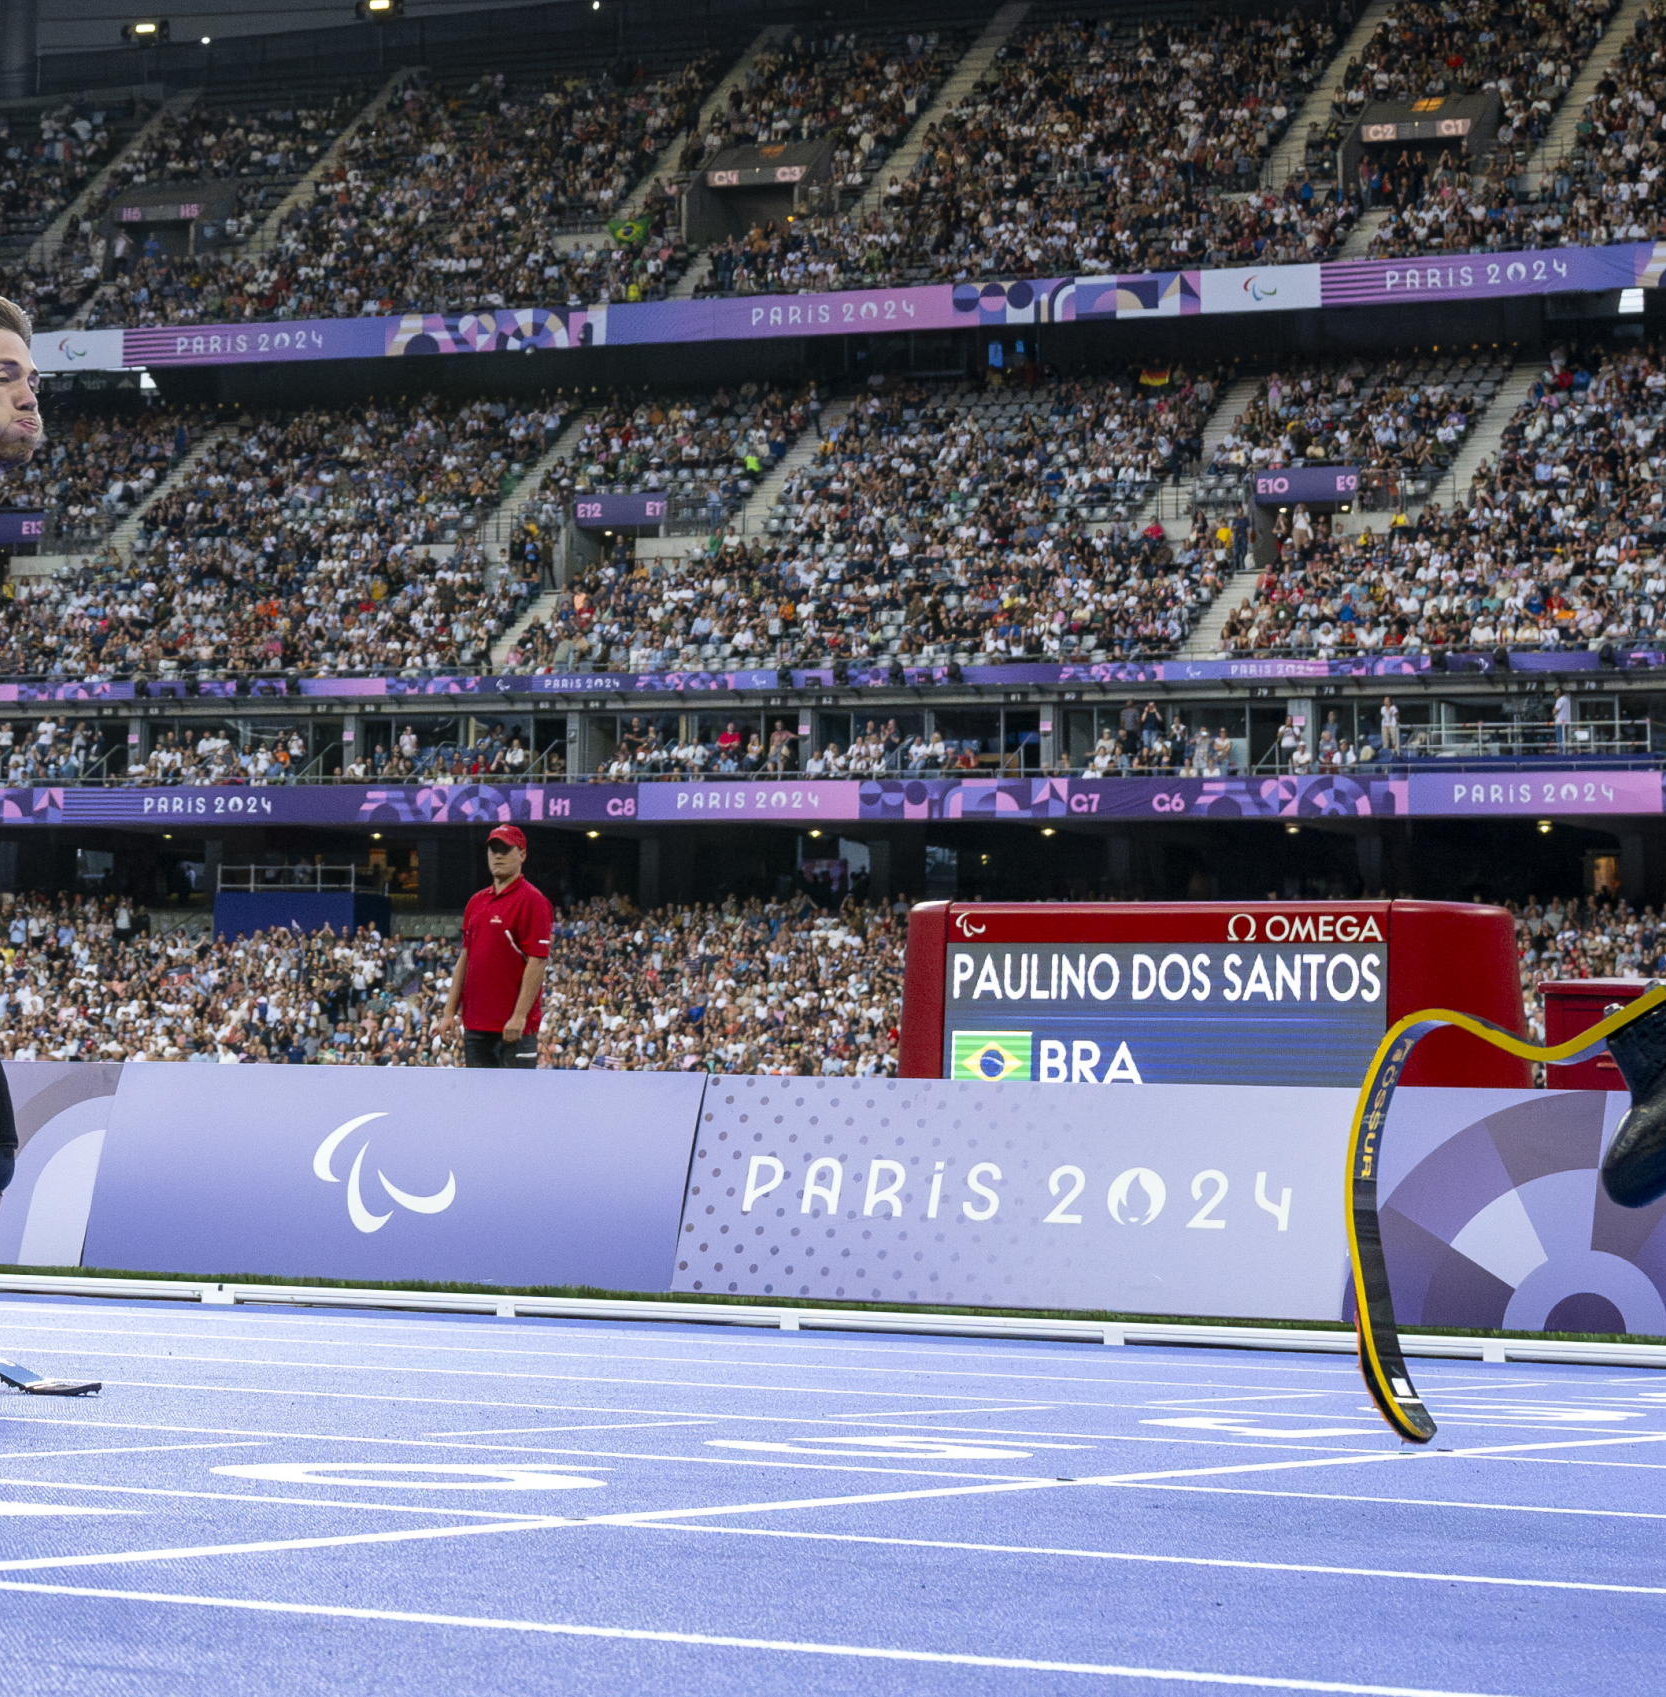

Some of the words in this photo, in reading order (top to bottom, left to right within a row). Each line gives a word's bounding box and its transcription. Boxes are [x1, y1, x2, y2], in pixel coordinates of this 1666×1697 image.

[1385, 265, 1474, 291] PARIS
[1486, 260, 1568, 286] 2024
[751, 304, 830, 327] PARIS
[842, 300, 915, 324] 2024
[176, 333, 248, 355] PARIS
[257, 330, 324, 351] 2024
[1256, 477, 1290, 495] E10
[577, 503, 603, 518] E12
[544, 677, 582, 689] PARIS
[585, 677, 621, 690] 2024
[676, 791, 746, 810] PARIS
[755, 789, 820, 809] 2024
[1069, 792, 1100, 813] G7
[1151, 792, 1185, 813] G6
[1453, 784, 1532, 803] PARIS
[1543, 783, 1615, 802] 2024
[143, 797, 206, 814] PARIS
[213, 796, 273, 814] 2024
[548, 797, 571, 817] H1
[605, 797, 636, 816] G8
[1265, 914, 1384, 943] OMEGA
[951, 952, 1120, 1002] PAULINO
[1131, 952, 1211, 1002] DOS
[1222, 952, 1381, 1003] SANTOS
[1039, 1039, 1144, 1085] BRA
[740, 1154, 1003, 1223] PARIS
[1041, 1163, 1294, 1232] 2024
